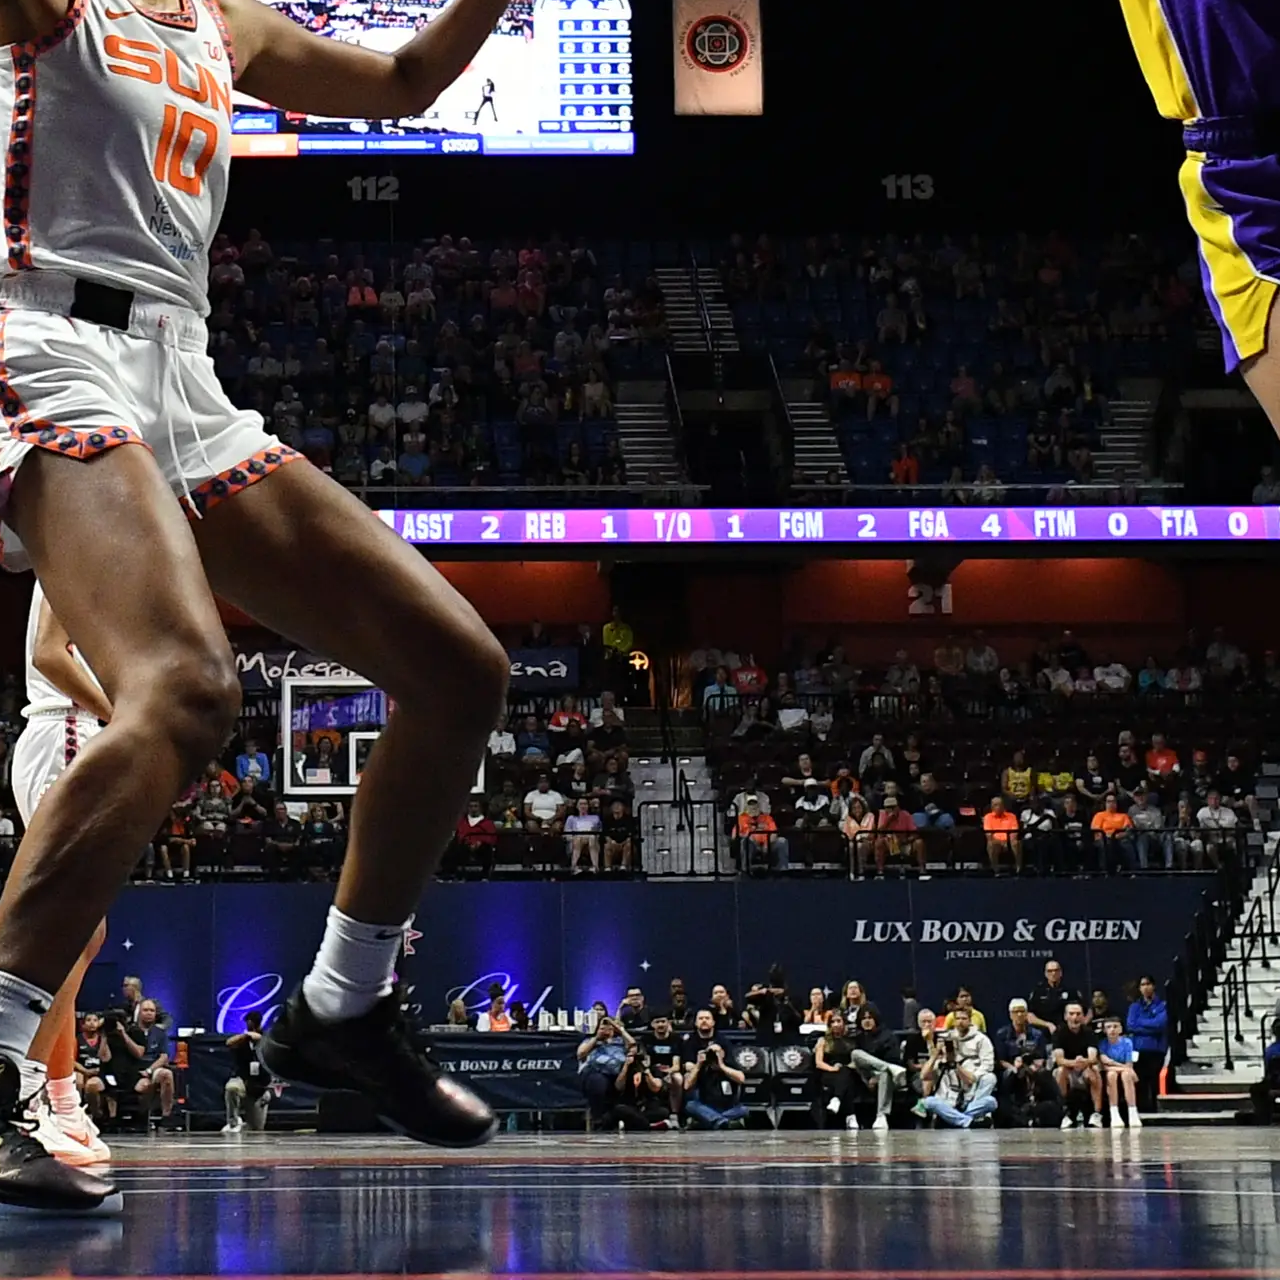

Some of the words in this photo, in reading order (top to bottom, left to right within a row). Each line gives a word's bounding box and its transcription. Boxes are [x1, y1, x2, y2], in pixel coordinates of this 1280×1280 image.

[104, 34, 232, 121] SUN
[153, 103, 218, 197] 10
[347, 176, 400, 202] 112
[881, 173, 935, 201] 113
[402, 513, 454, 540] ASST
[480, 516, 501, 539] 2
[525, 512, 566, 539] REB
[601, 515, 618, 539] 1
[653, 511, 691, 542] T/O
[727, 515, 744, 538] 1
[779, 511, 824, 538] FGM
[857, 514, 877, 538] 2
[908, 510, 949, 538] FGA
[980, 513, 1002, 537] 4
[1034, 510, 1076, 537] FTM
[1108, 512, 1128, 537] 0
[1161, 510, 1198, 537] FTA
[1228, 512, 1249, 536] 0
[907, 583, 953, 614] 21
[509, 658, 568, 679] ena
[1012, 918, 1037, 942] &
[439, 1059, 457, 1073] UX
